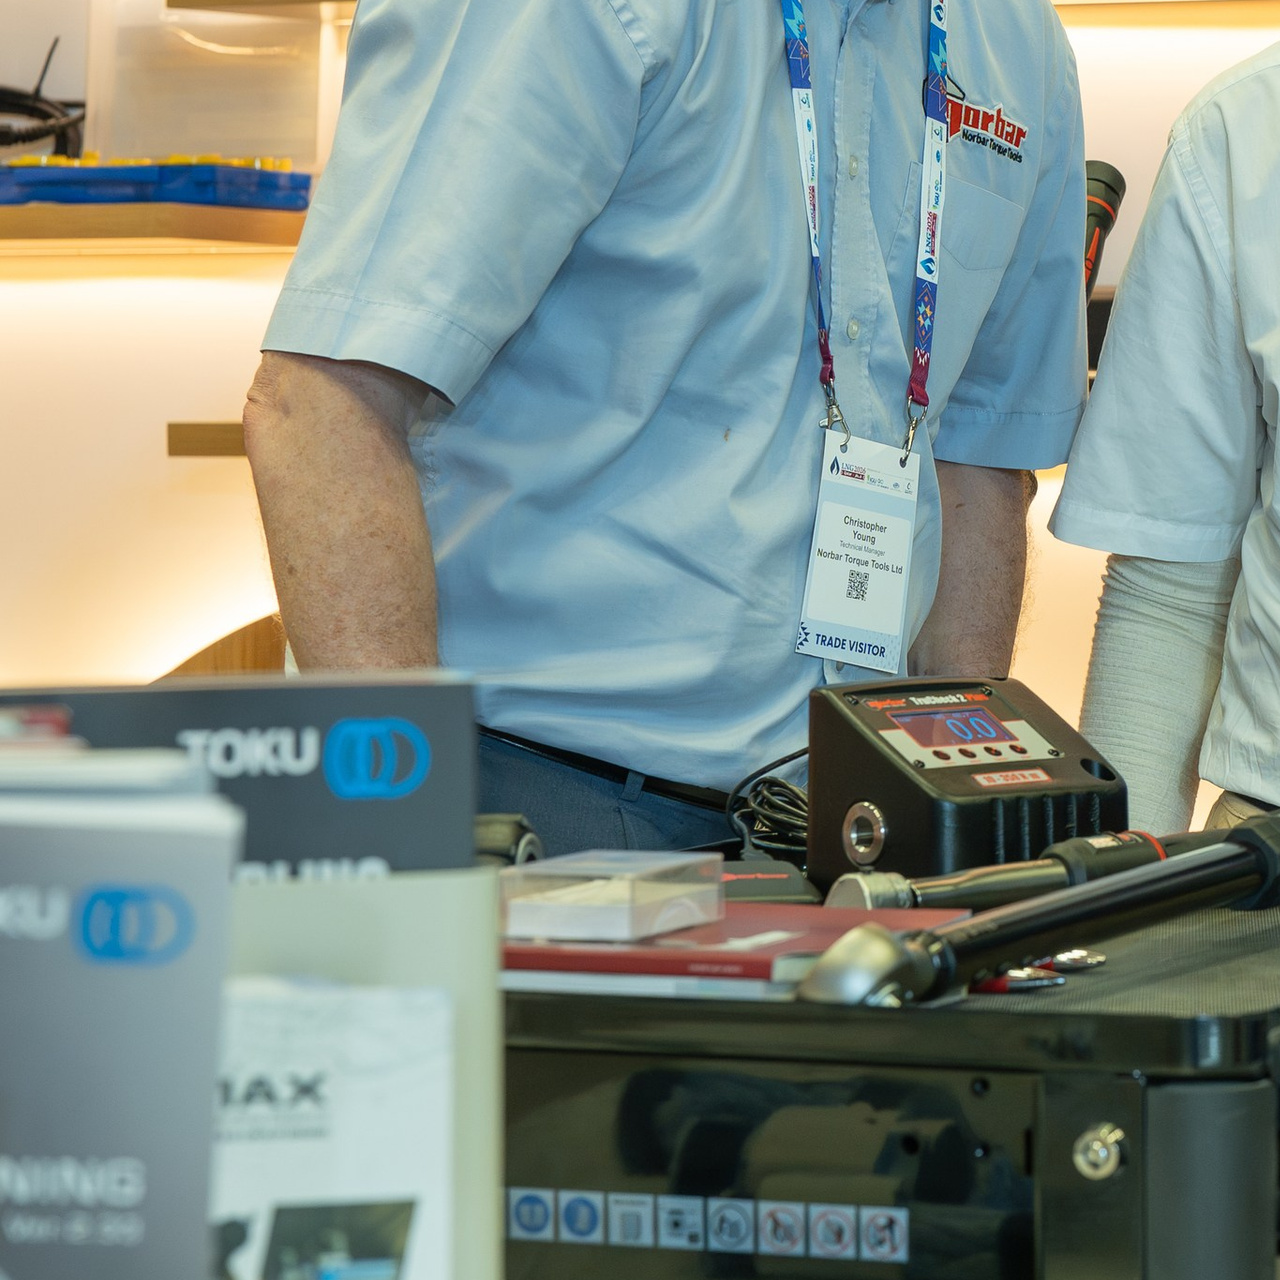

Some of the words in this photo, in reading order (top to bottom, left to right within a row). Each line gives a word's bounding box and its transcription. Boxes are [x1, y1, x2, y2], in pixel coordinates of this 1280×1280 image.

[962, 129, 990, 147] Norbar
[989, 138, 1008, 157] Torque
[1007, 147, 1023, 163] Tools
[843, 515, 887, 534] Christopher
[840, 540, 863, 553] Technical
[863, 545, 886, 557] Manager
[852, 530, 876, 546] Young
[817, 548, 843, 562] Norbar
[844, 553, 869, 568] Torque
[871, 558, 890, 572] Tools
[891, 564, 903, 575] Ltd
[815, 633, 847, 651] TRADE
[848, 639, 886, 658] VISITOR
[955, 693, 967, 703] 2
[946, 717, 996, 740] 0.0
